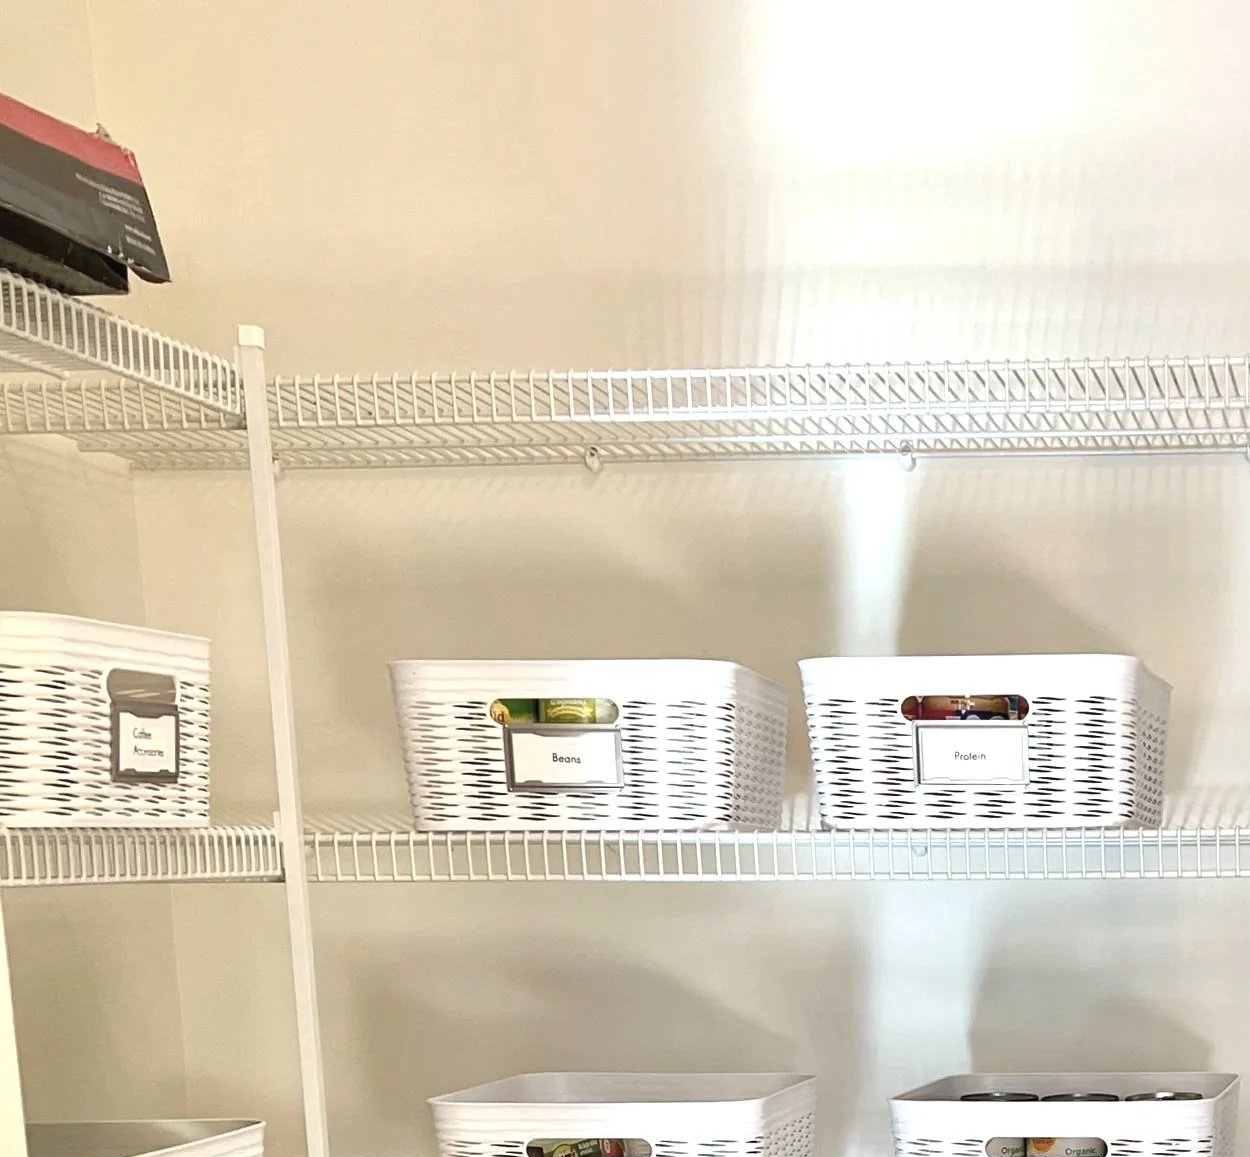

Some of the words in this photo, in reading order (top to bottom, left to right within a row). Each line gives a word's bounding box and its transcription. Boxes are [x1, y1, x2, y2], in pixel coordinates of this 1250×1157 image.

[552, 752, 581, 764] Beans
[954, 751, 987, 761] Protein
[1064, 1147, 1097, 1156] Organic
